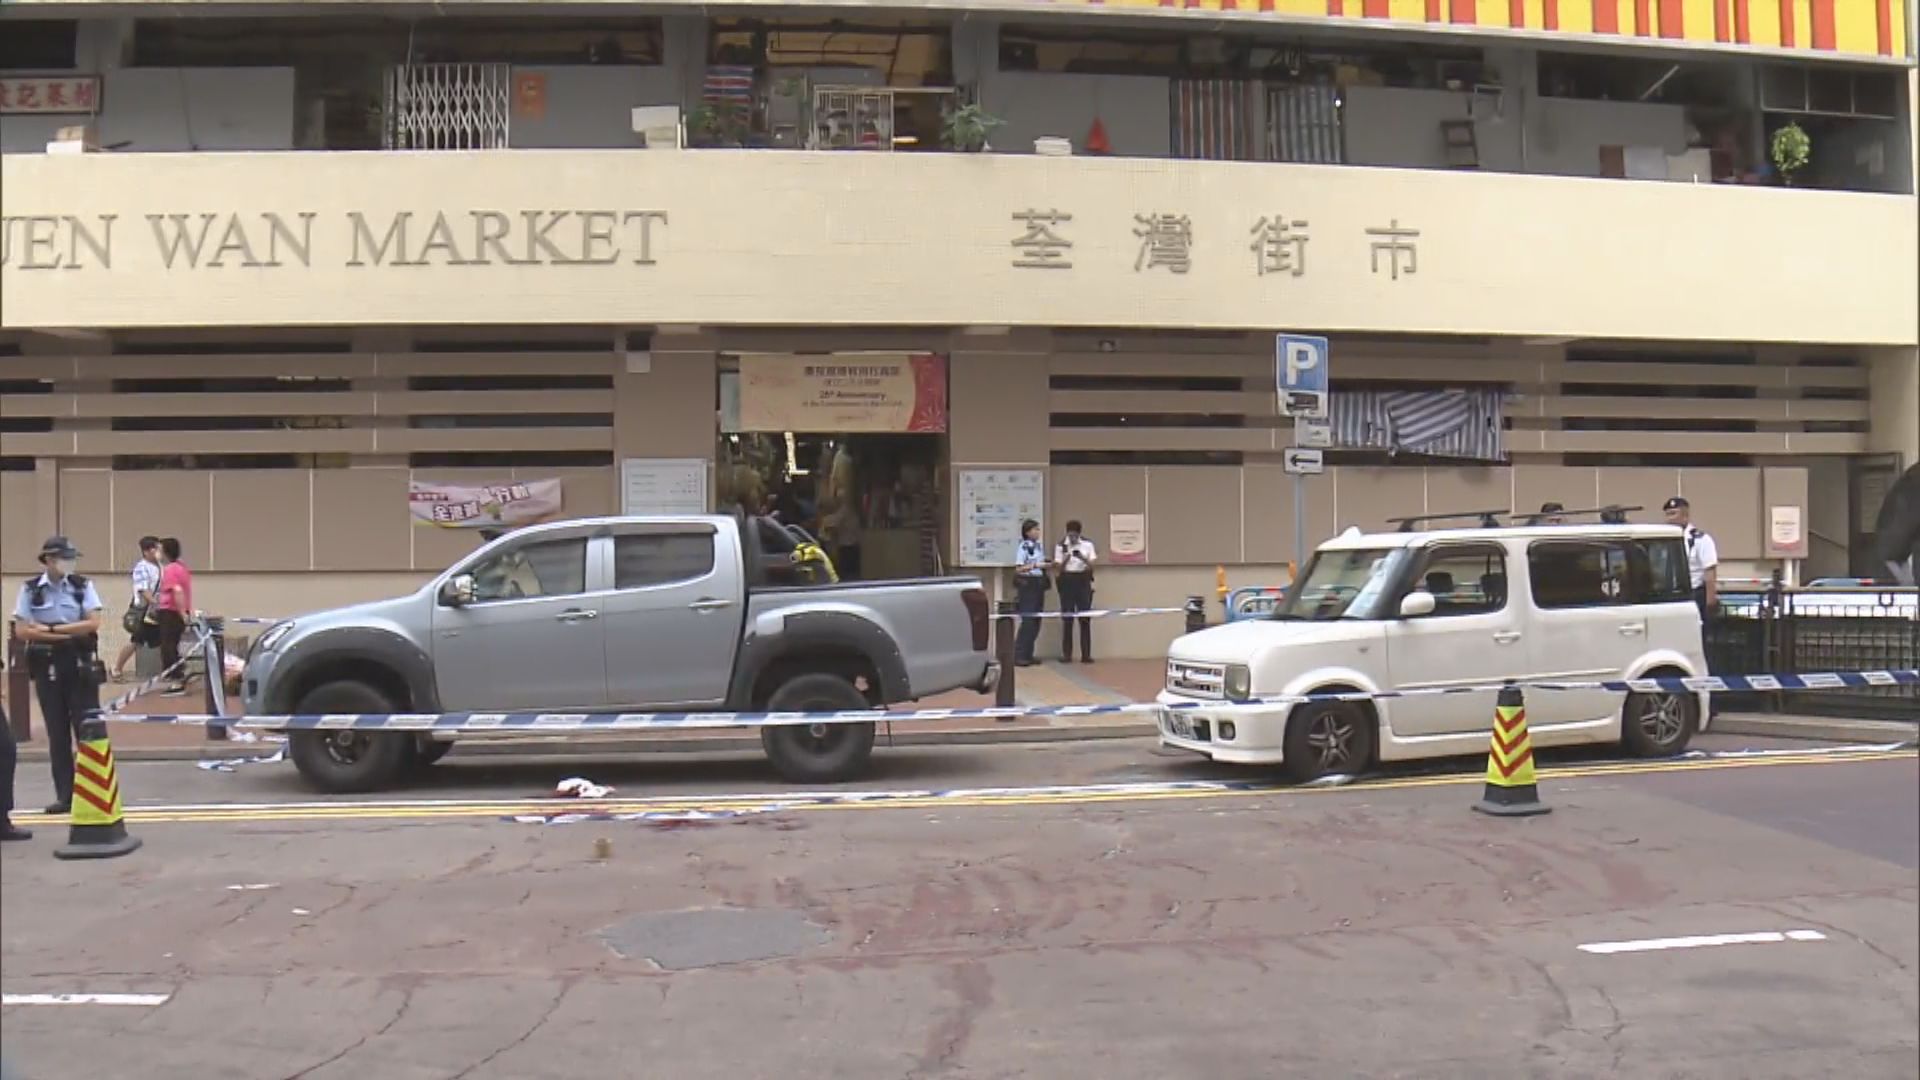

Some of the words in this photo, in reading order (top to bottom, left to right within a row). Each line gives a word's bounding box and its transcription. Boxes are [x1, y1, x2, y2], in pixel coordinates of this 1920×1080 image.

[145, 212, 317, 269] WAN
[345, 209, 668, 267] MARKET
[1011, 208, 1420, 280] 荃灣街市
[1286, 341, 1319, 386] P
